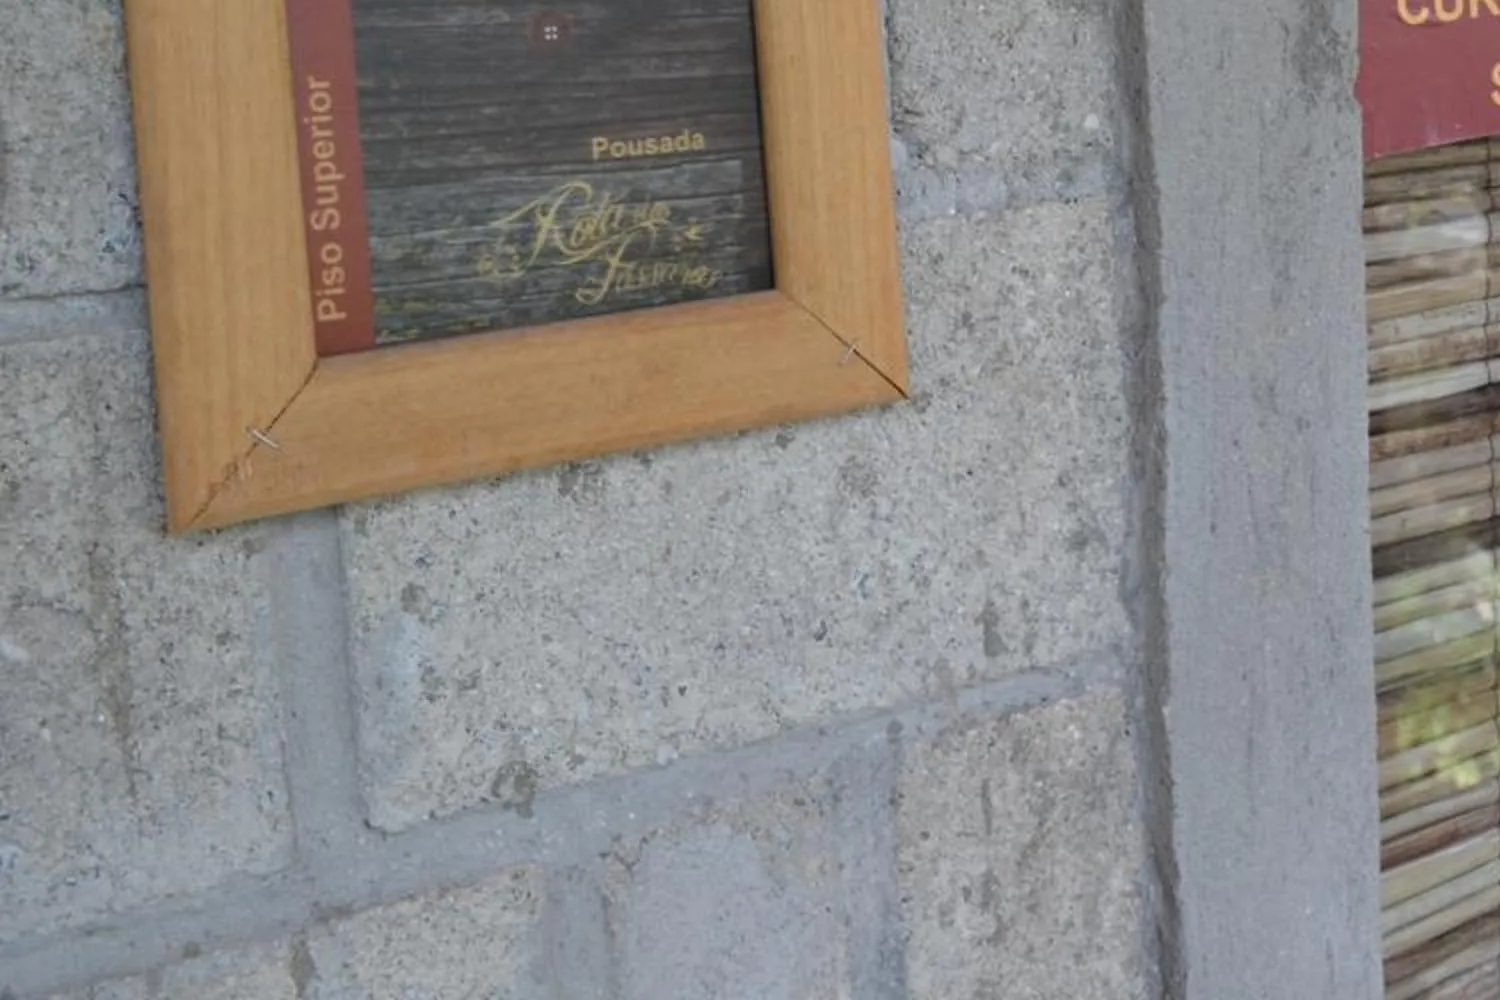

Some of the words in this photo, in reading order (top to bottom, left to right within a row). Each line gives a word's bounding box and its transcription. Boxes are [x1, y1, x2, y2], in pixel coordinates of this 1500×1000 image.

[303, 76, 346, 230] Superior
[591, 130, 705, 160] Pousada
[316, 242, 346, 322] Piso
